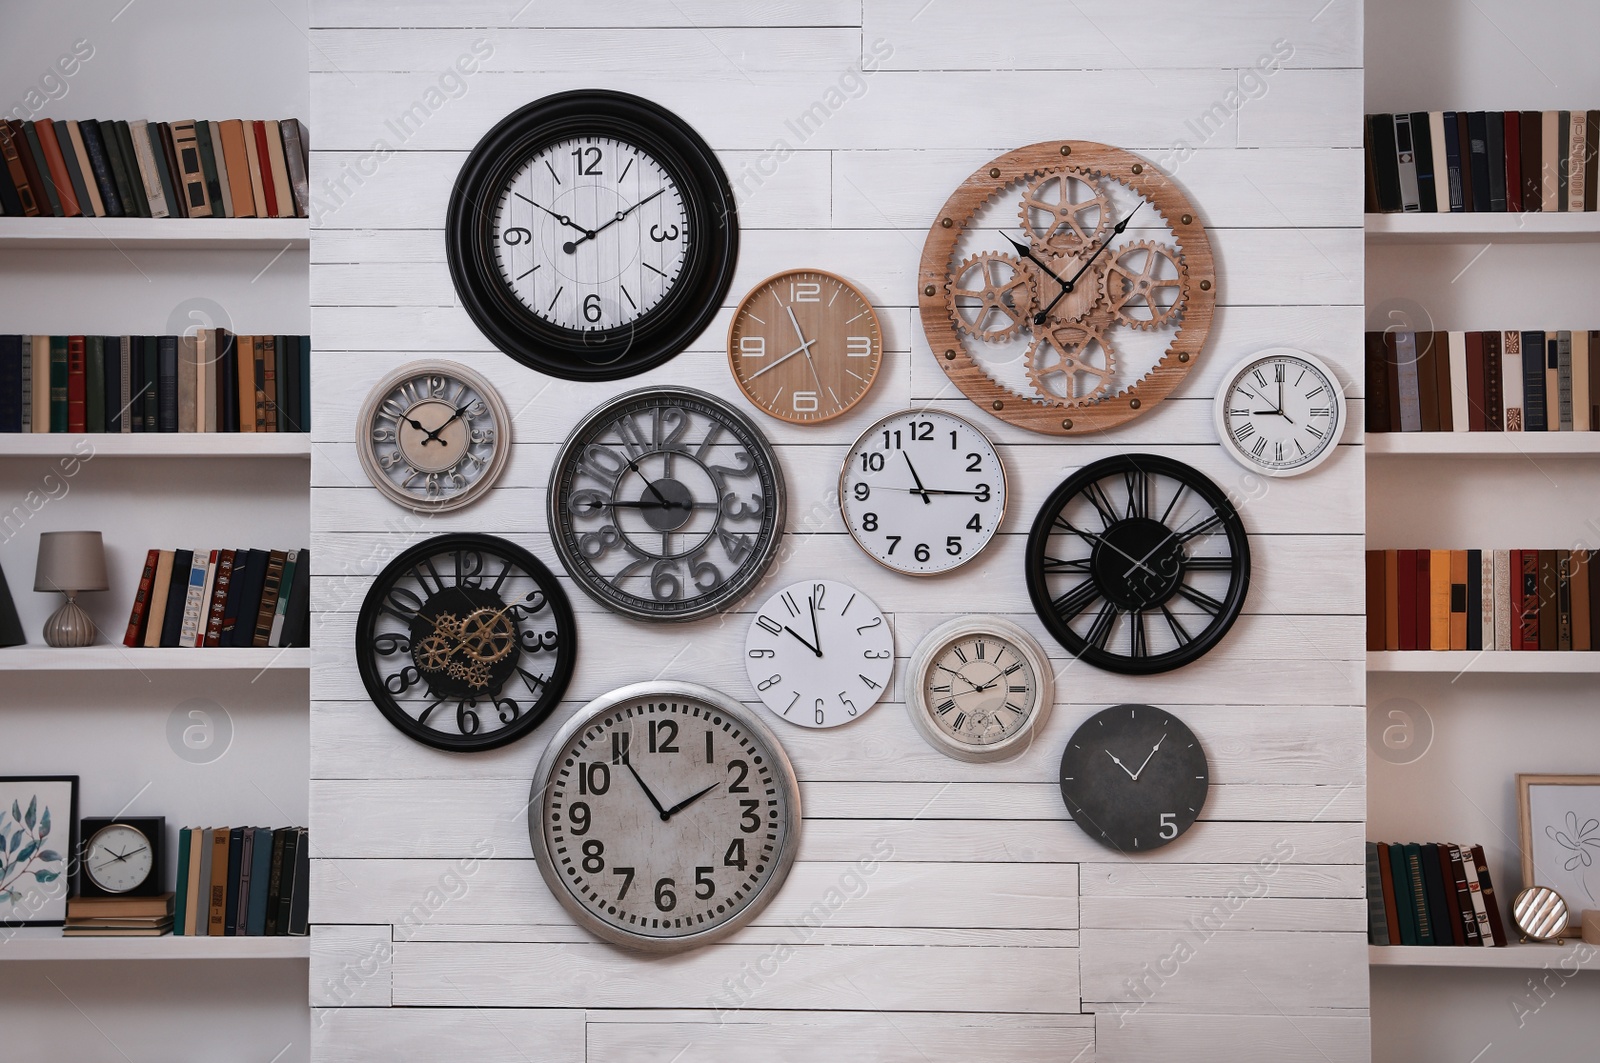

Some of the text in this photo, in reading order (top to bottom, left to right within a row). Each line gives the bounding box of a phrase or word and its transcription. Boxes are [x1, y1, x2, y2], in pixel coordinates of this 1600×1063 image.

[572, 147, 602, 175] 12
[503, 227, 531, 245] 9
[650, 224, 678, 242] 3
[791, 283, 820, 302] 12
[583, 294, 601, 322] 6
[740, 337, 765, 357] 9
[847, 337, 871, 357] 3
[397, 381, 420, 406] 11
[423, 376, 445, 398] 12
[452, 382, 465, 403] 1
[376, 399, 404, 422] 10
[464, 401, 487, 420] 2
[793, 392, 818, 411] 6
[373, 428, 396, 441] 9
[470, 429, 493, 443] 3
[612, 415, 650, 457] 11
[649, 408, 692, 451] 12
[695, 422, 720, 459] 1
[883, 430, 901, 449] 11
[909, 422, 934, 440] 12
[950, 431, 956, 450] 1
[379, 451, 401, 469] 8
[461, 452, 485, 470] 4
[577, 444, 625, 489] 10
[709, 452, 754, 489] 2
[860, 452, 884, 471] 10
[966, 453, 982, 472] 2
[401, 468, 419, 488] 7
[425, 473, 439, 496] 6
[448, 467, 466, 489] 5
[568, 489, 611, 517] 9
[854, 482, 870, 501] 9
[974, 484, 990, 502] 3
[721, 492, 763, 520] 3
[862, 512, 878, 531] 8
[966, 513, 982, 532] 4
[579, 525, 620, 558] 8
[716, 527, 753, 562] 4
[886, 536, 901, 554] 7
[914, 543, 930, 562] 6
[946, 536, 962, 555] 5
[449, 551, 483, 588] 12
[611, 544, 649, 586] 7
[687, 548, 720, 593] 5
[407, 559, 445, 598] 11
[486, 561, 513, 596] 1
[651, 559, 680, 601] 6
[379, 587, 423, 629] 10
[511, 590, 547, 621] 2
[781, 591, 800, 617] 11
[813, 584, 825, 610] 12
[841, 593, 855, 616] 1
[756, 615, 782, 636] 10
[857, 617, 881, 635] 2
[373, 633, 411, 655] 9
[521, 630, 558, 652] 3
[749, 649, 775, 658] 9
[864, 650, 890, 659] 3
[385, 666, 420, 695] 8
[515, 666, 551, 693] 4
[757, 674, 781, 691] 8
[859, 674, 882, 689] 4
[418, 684, 448, 724] 7
[457, 695, 479, 735] 6
[489, 684, 519, 724] 5
[784, 691, 800, 715] 7
[815, 698, 823, 724] 6
[839, 691, 857, 716] 5
[612, 732, 629, 765] 11
[649, 719, 679, 753] 12
[705, 731, 714, 763] 1
[579, 761, 610, 795] 10
[727, 760, 749, 793] 2
[569, 801, 591, 835] 9
[739, 800, 761, 833] 3
[1159, 813, 1178, 839] 5
[582, 839, 605, 873] 8
[724, 838, 747, 871] 4
[613, 867, 635, 900] 7
[654, 878, 677, 912] 6
[695, 867, 715, 900] 5
